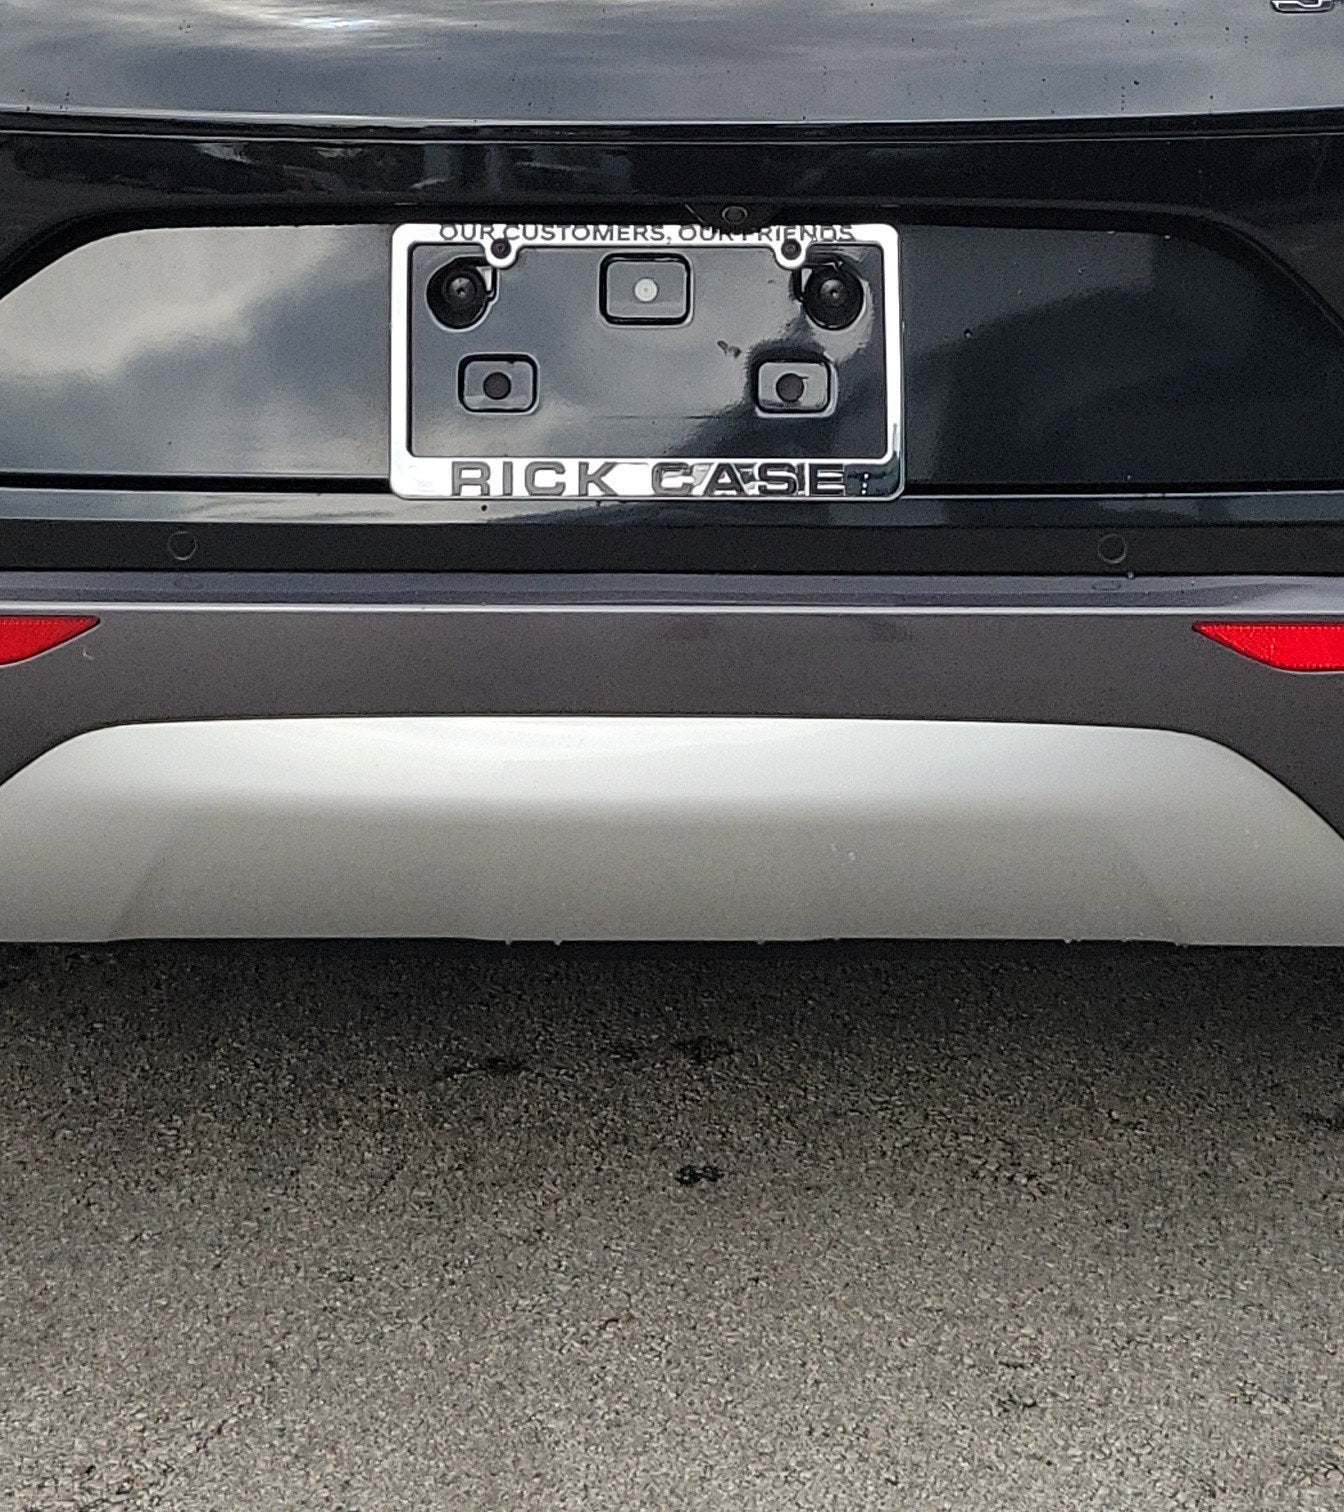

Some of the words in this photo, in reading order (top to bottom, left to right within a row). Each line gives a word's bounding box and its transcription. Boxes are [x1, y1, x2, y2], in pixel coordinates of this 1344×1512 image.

[439, 224, 495, 241] OUR
[451, 460, 620, 497] RICK
[651, 460, 848, 497] CASE
